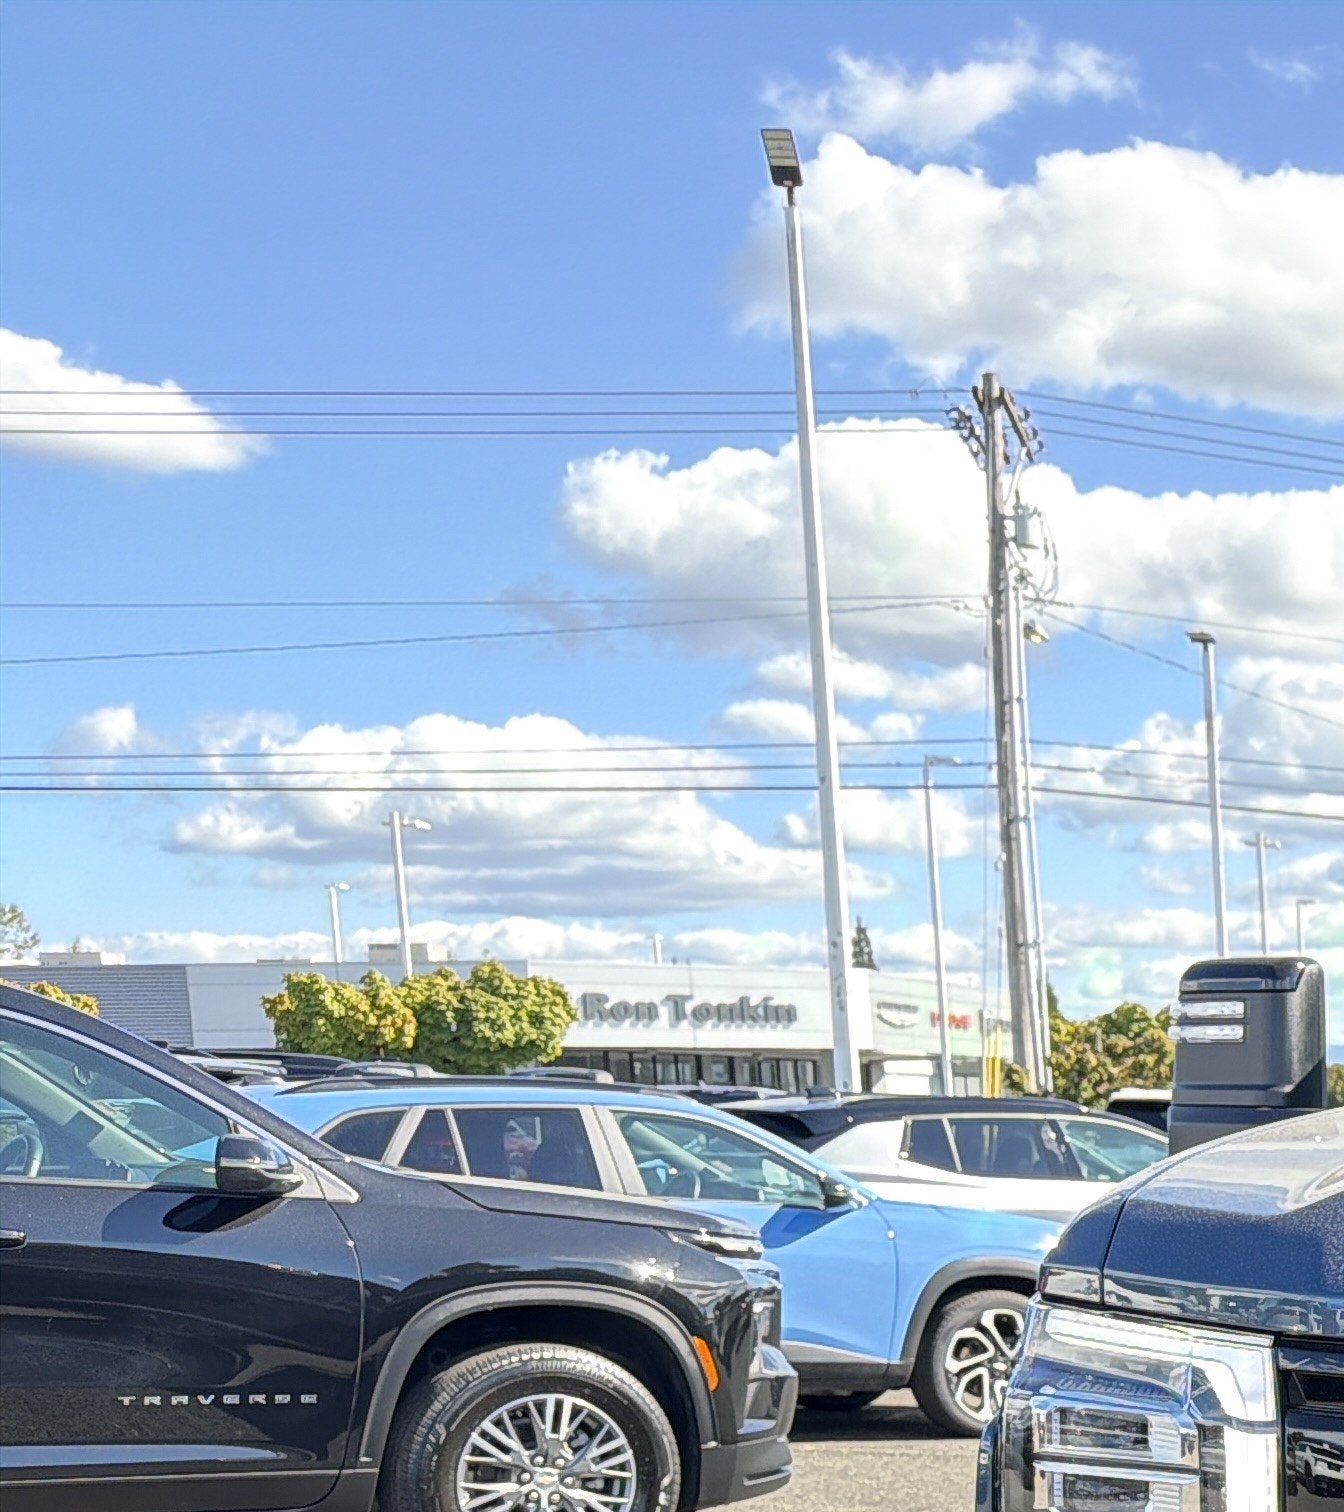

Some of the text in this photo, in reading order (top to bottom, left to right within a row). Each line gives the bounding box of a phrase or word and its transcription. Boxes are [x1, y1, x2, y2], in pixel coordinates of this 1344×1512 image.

[579, 992, 798, 1026] Ron Tonkin
[117, 1393, 318, 1406] TRAVERSE
